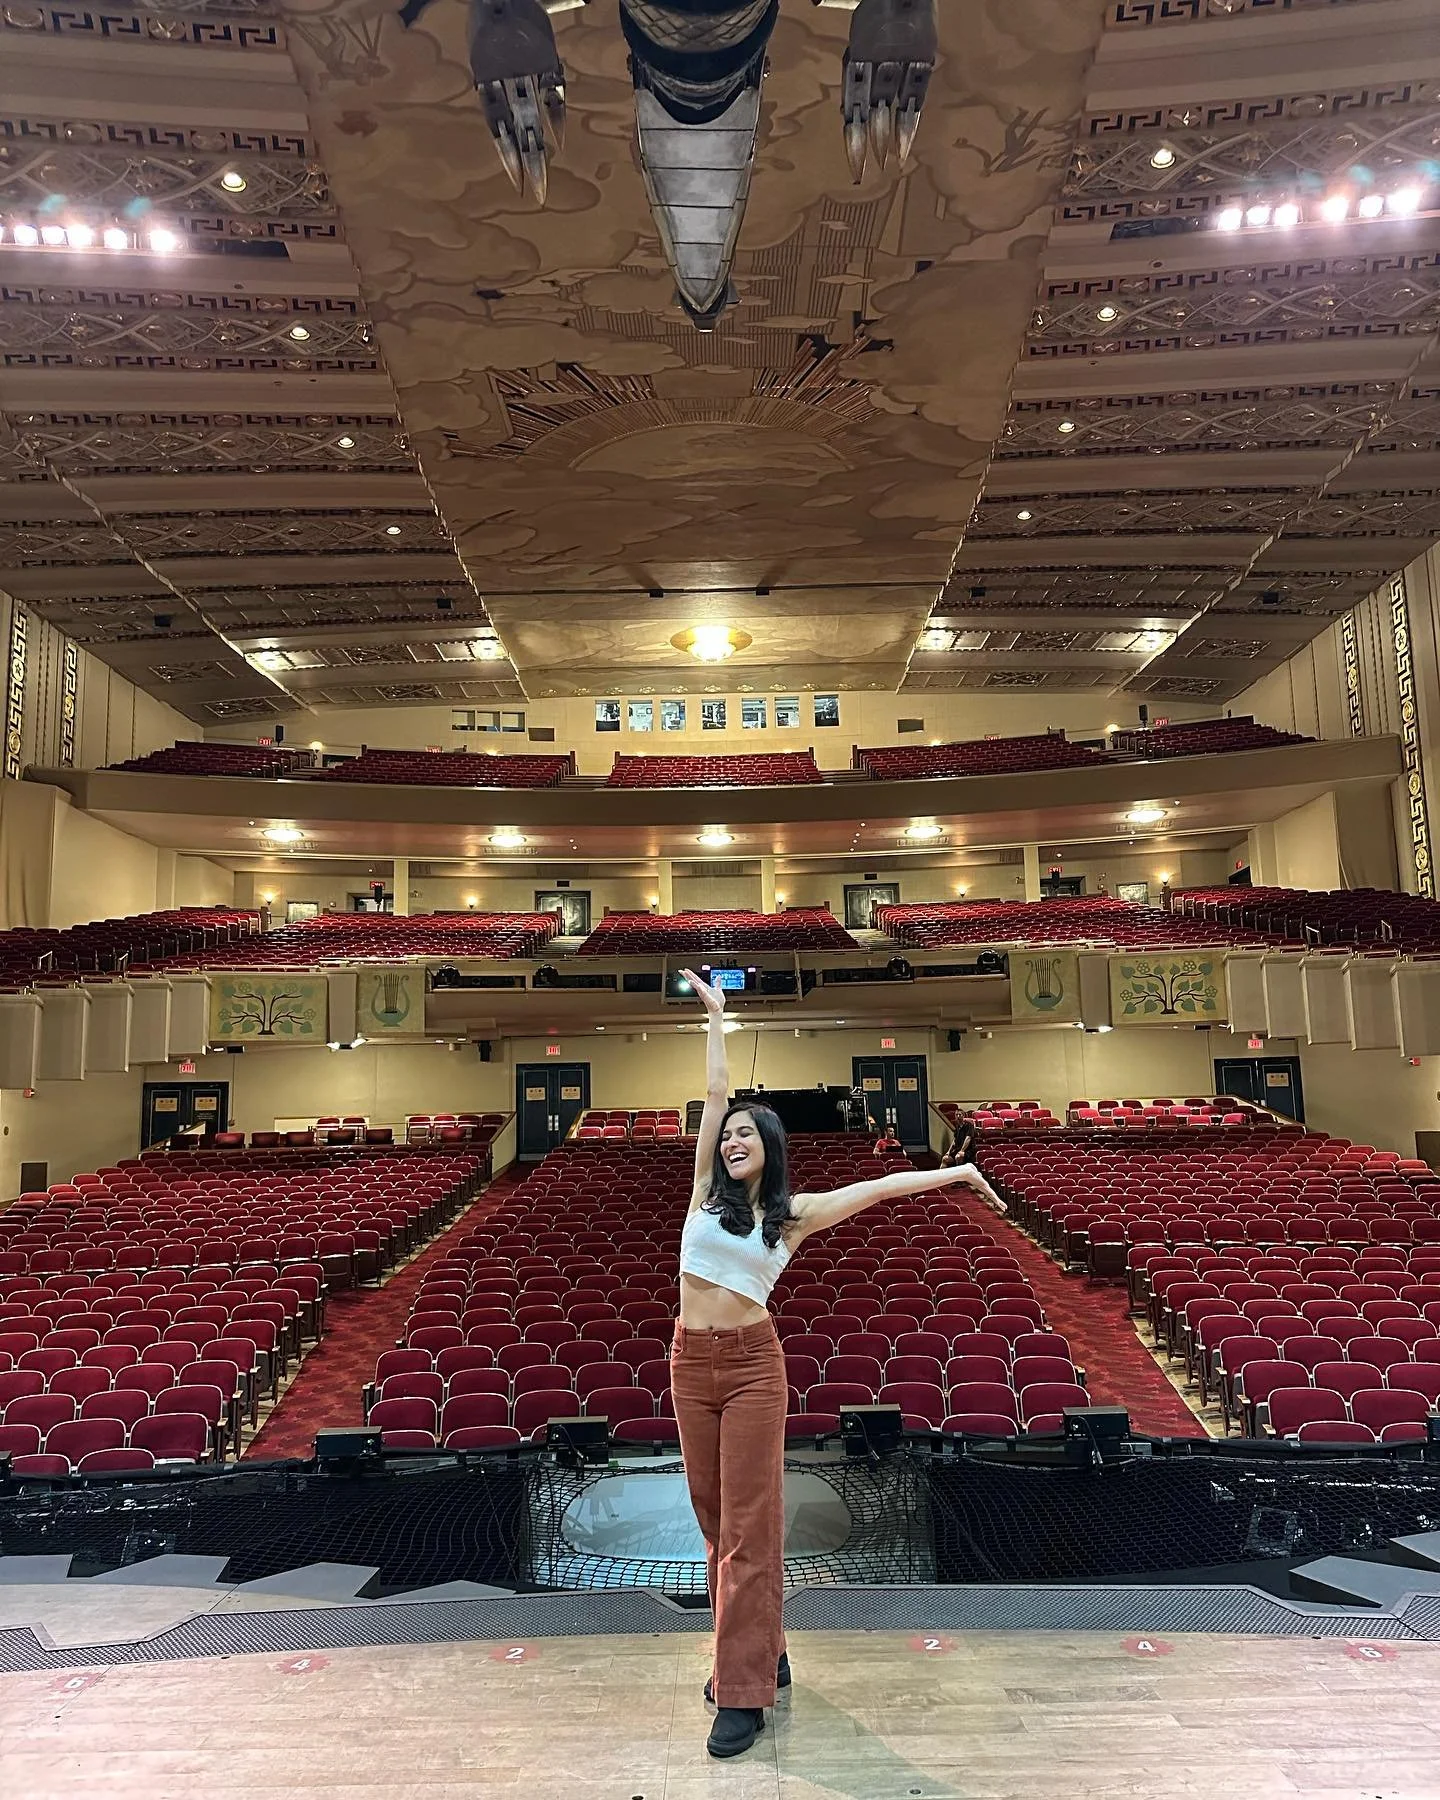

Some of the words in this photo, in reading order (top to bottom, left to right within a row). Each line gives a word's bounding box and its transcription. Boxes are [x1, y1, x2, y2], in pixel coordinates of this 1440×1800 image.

[923, 1638, 942, 1650] 2
[1137, 1640, 1157, 1652] 4
[505, 1647, 525, 1660] 2
[1358, 1646, 1383, 1658] 6
[290, 1658, 312, 1671] 4
[63, 1676, 88, 1689] 6
